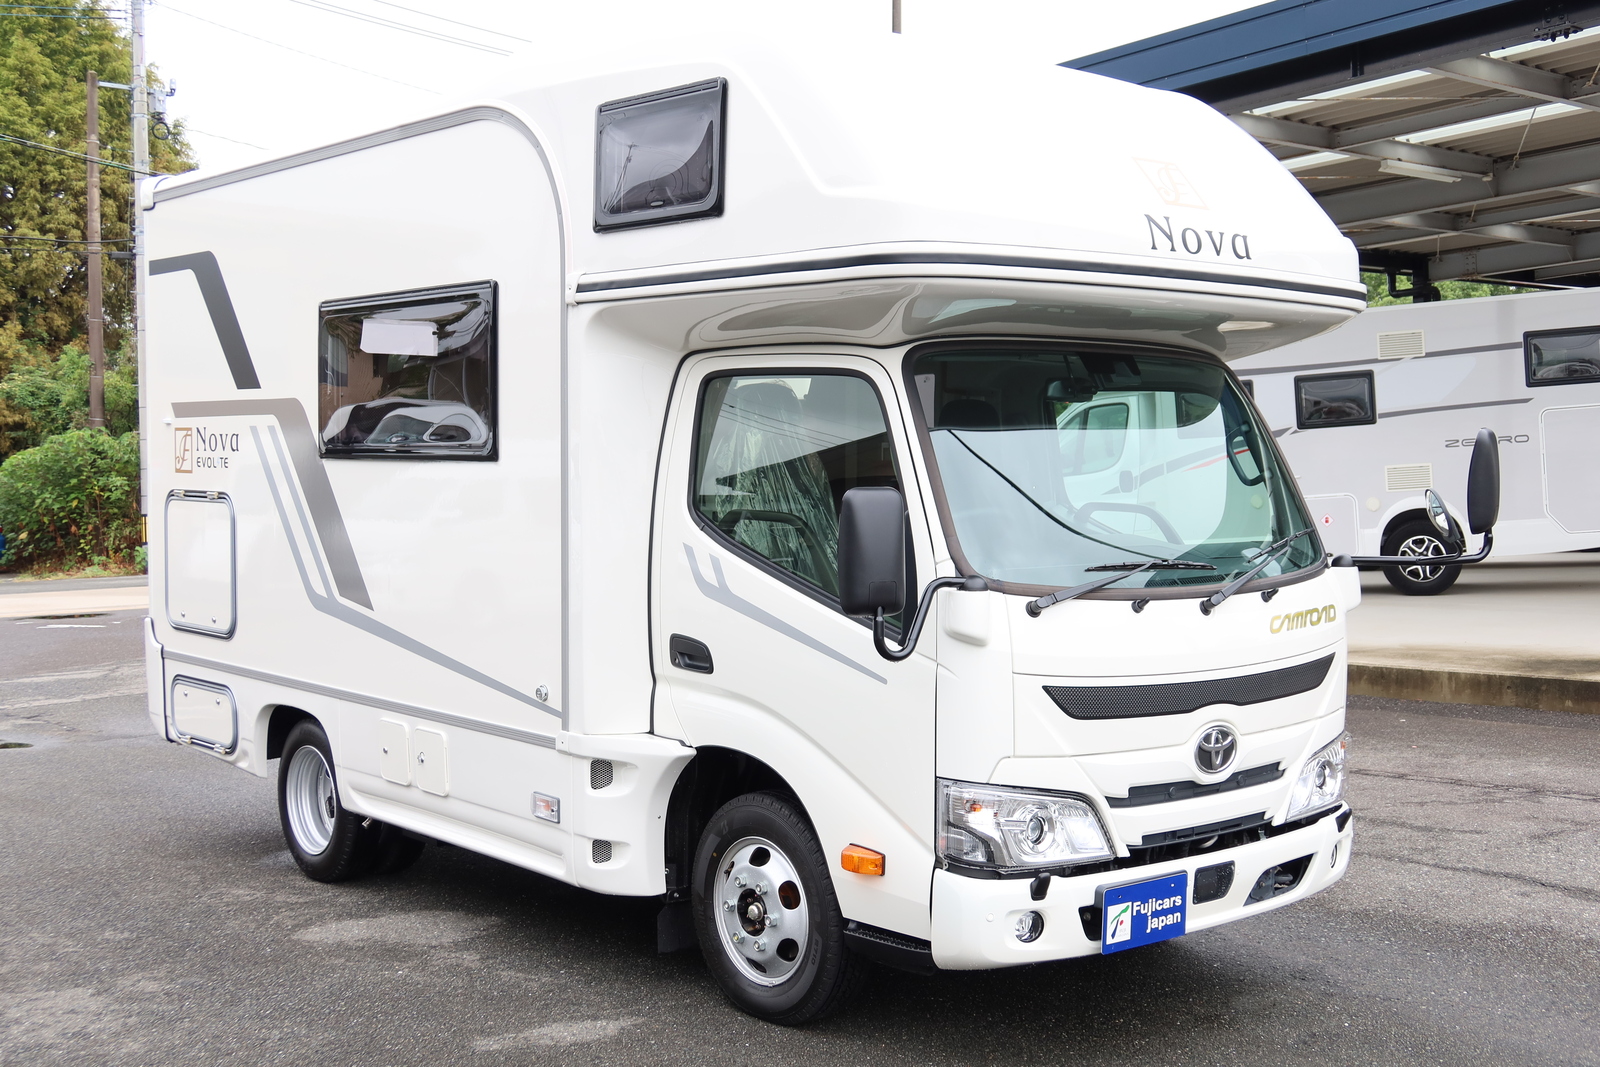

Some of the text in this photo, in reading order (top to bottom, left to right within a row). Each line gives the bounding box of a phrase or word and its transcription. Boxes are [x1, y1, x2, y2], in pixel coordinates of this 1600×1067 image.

[1144, 213, 1252, 260] Nova
[196, 427, 239, 452] Nova
[1445, 434, 1529, 448] ZERO
[1132, 895, 1182, 916] Fujicars
[1146, 912, 1181, 933] japan
